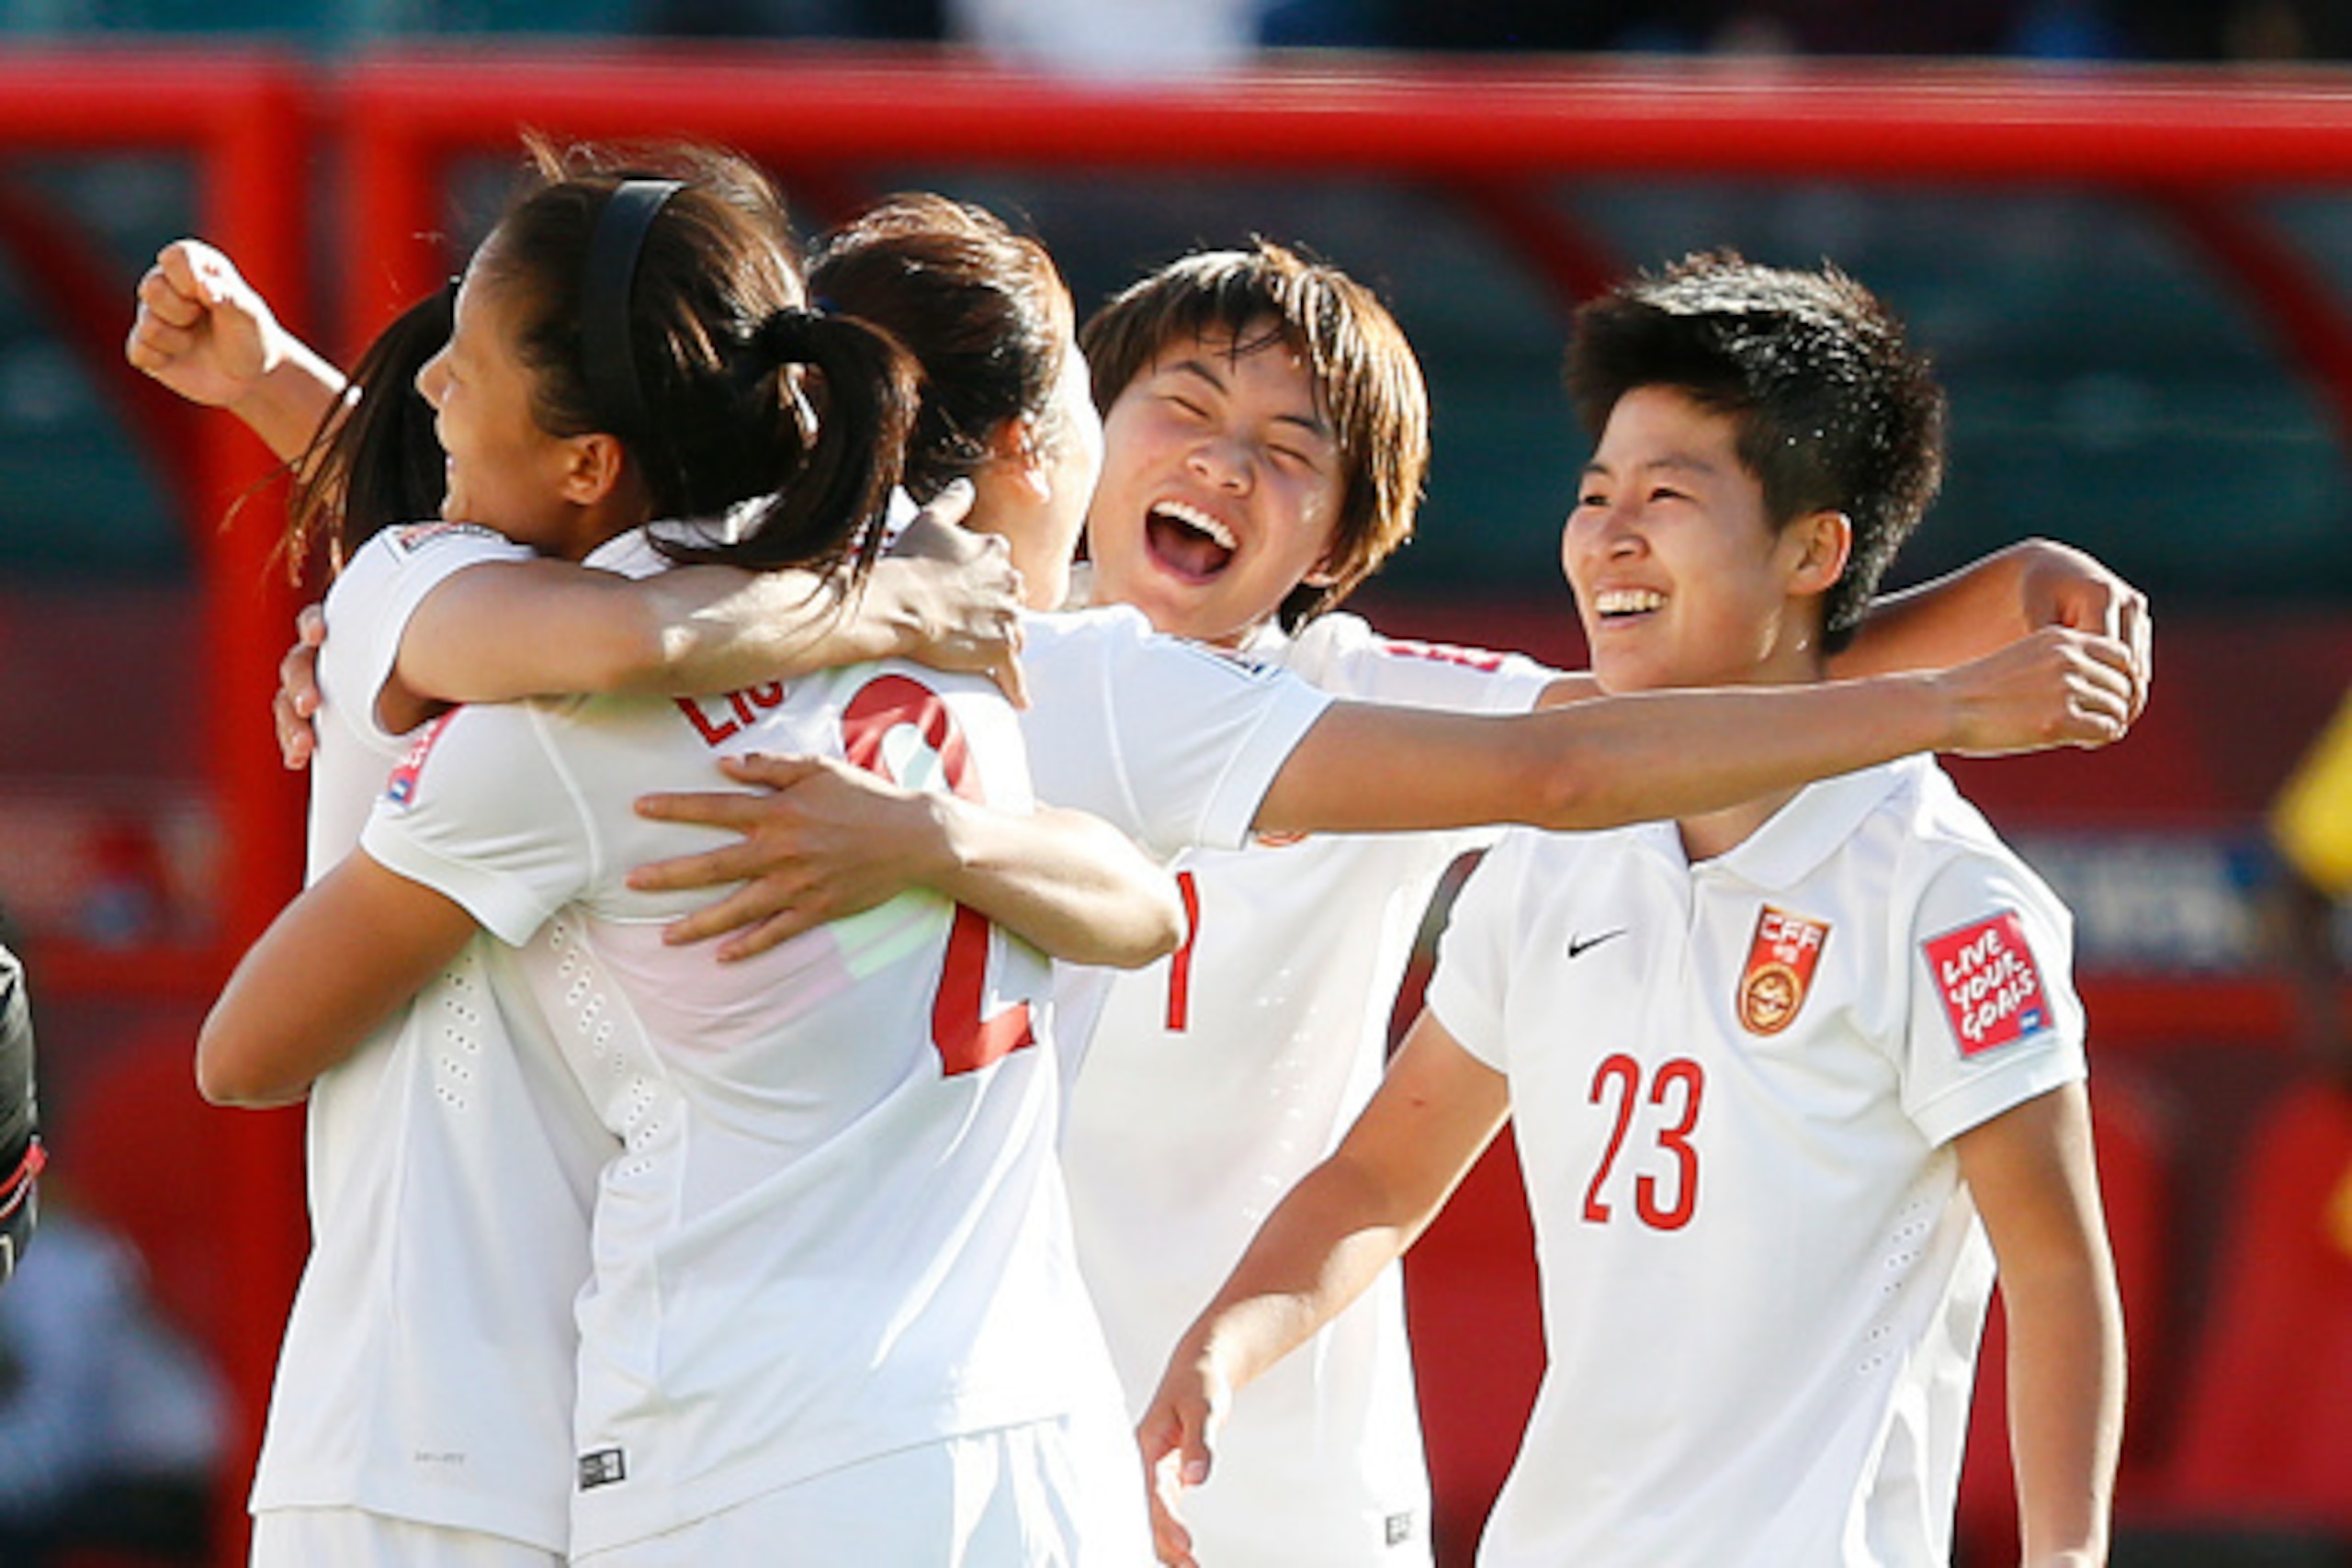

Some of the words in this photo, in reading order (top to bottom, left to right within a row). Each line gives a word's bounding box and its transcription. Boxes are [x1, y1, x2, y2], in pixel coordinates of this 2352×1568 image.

[1941, 929, 2003, 987] LIVE
[1950, 950, 2026, 1011] YOUR
[1962, 968, 2037, 1043] GOALS
[1581, 1053, 1705, 1233] 23
